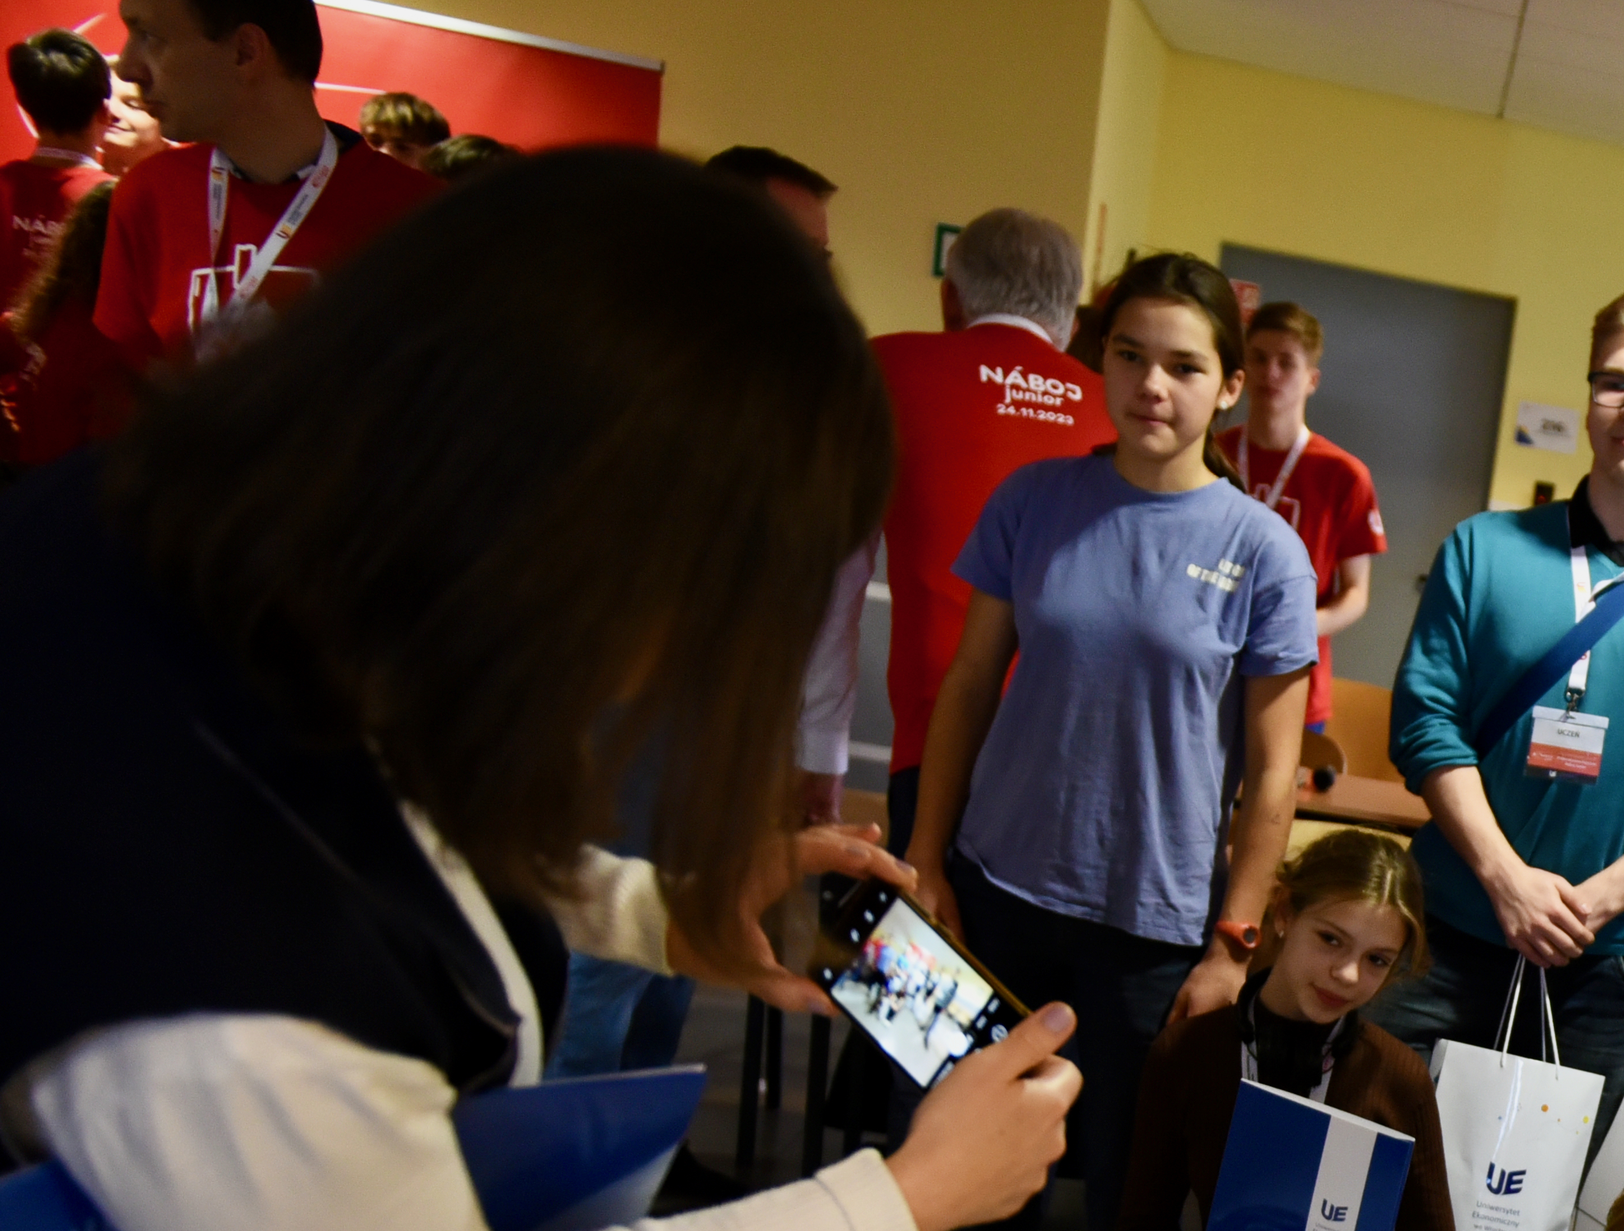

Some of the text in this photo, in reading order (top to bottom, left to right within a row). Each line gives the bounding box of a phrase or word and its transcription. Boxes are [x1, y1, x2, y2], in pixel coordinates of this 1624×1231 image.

[980, 364, 1082, 401] NÁBOJ
[1004, 385, 1064, 407] junior
[997, 403, 1074, 426] 24.11.2023
[1556, 727, 1581, 739] UCZEŃ
[1486, 1161, 1527, 1196] UE
[1321, 1198, 1348, 1222] UE
[1476, 1201, 1520, 1216] Uniwersytet
[1472, 1211, 1520, 1229] Ekonomiczny
